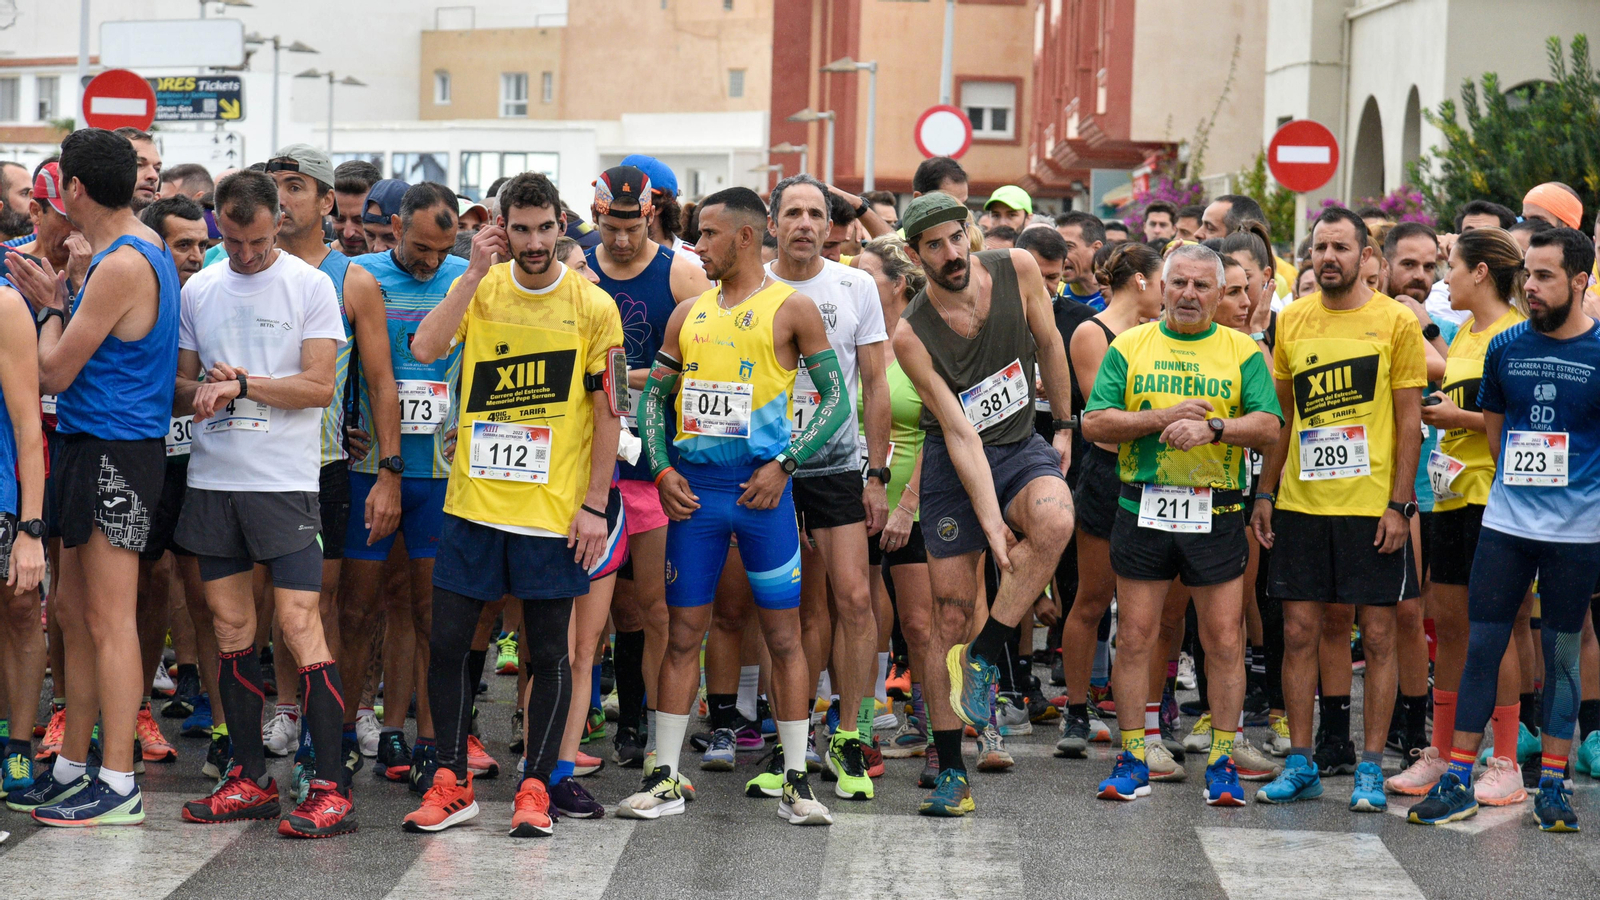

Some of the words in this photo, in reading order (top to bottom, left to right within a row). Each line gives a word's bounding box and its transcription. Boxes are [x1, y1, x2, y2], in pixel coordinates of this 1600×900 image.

[198, 80, 240, 92] Tickets
[1154, 360, 1200, 372] RUNNERS
[1542, 363, 1555, 371] DEL
[1556, 364, 1591, 377] ESTRECHO
[494, 360, 546, 392] XIII
[1308, 366, 1352, 398] XIII
[1557, 372, 1588, 384] SERRANO
[524, 387, 550, 395] Estrecho
[821, 370, 840, 417] SPORTING
[1133, 373, 1232, 399] BARREÑOS
[400, 399, 432, 420] 173
[486, 398, 515, 406] Memorial
[699, 394, 732, 416] 170
[980, 386, 1011, 417] 381
[487, 412, 496, 422] 4
[519, 408, 546, 416] TARIFA
[795, 409, 803, 428] 1
[1332, 408, 1357, 418] TARIFA
[1530, 404, 1556, 423] 8D
[483, 425, 499, 433] XIII
[790, 417, 826, 454] PURSUITS
[1450, 428, 1467, 438] TARIFA
[1530, 422, 1552, 431] TARIFA
[490, 443, 528, 468] 112
[1314, 445, 1348, 467] 289
[1514, 451, 1547, 472] 223
[1156, 498, 1190, 519] 211
